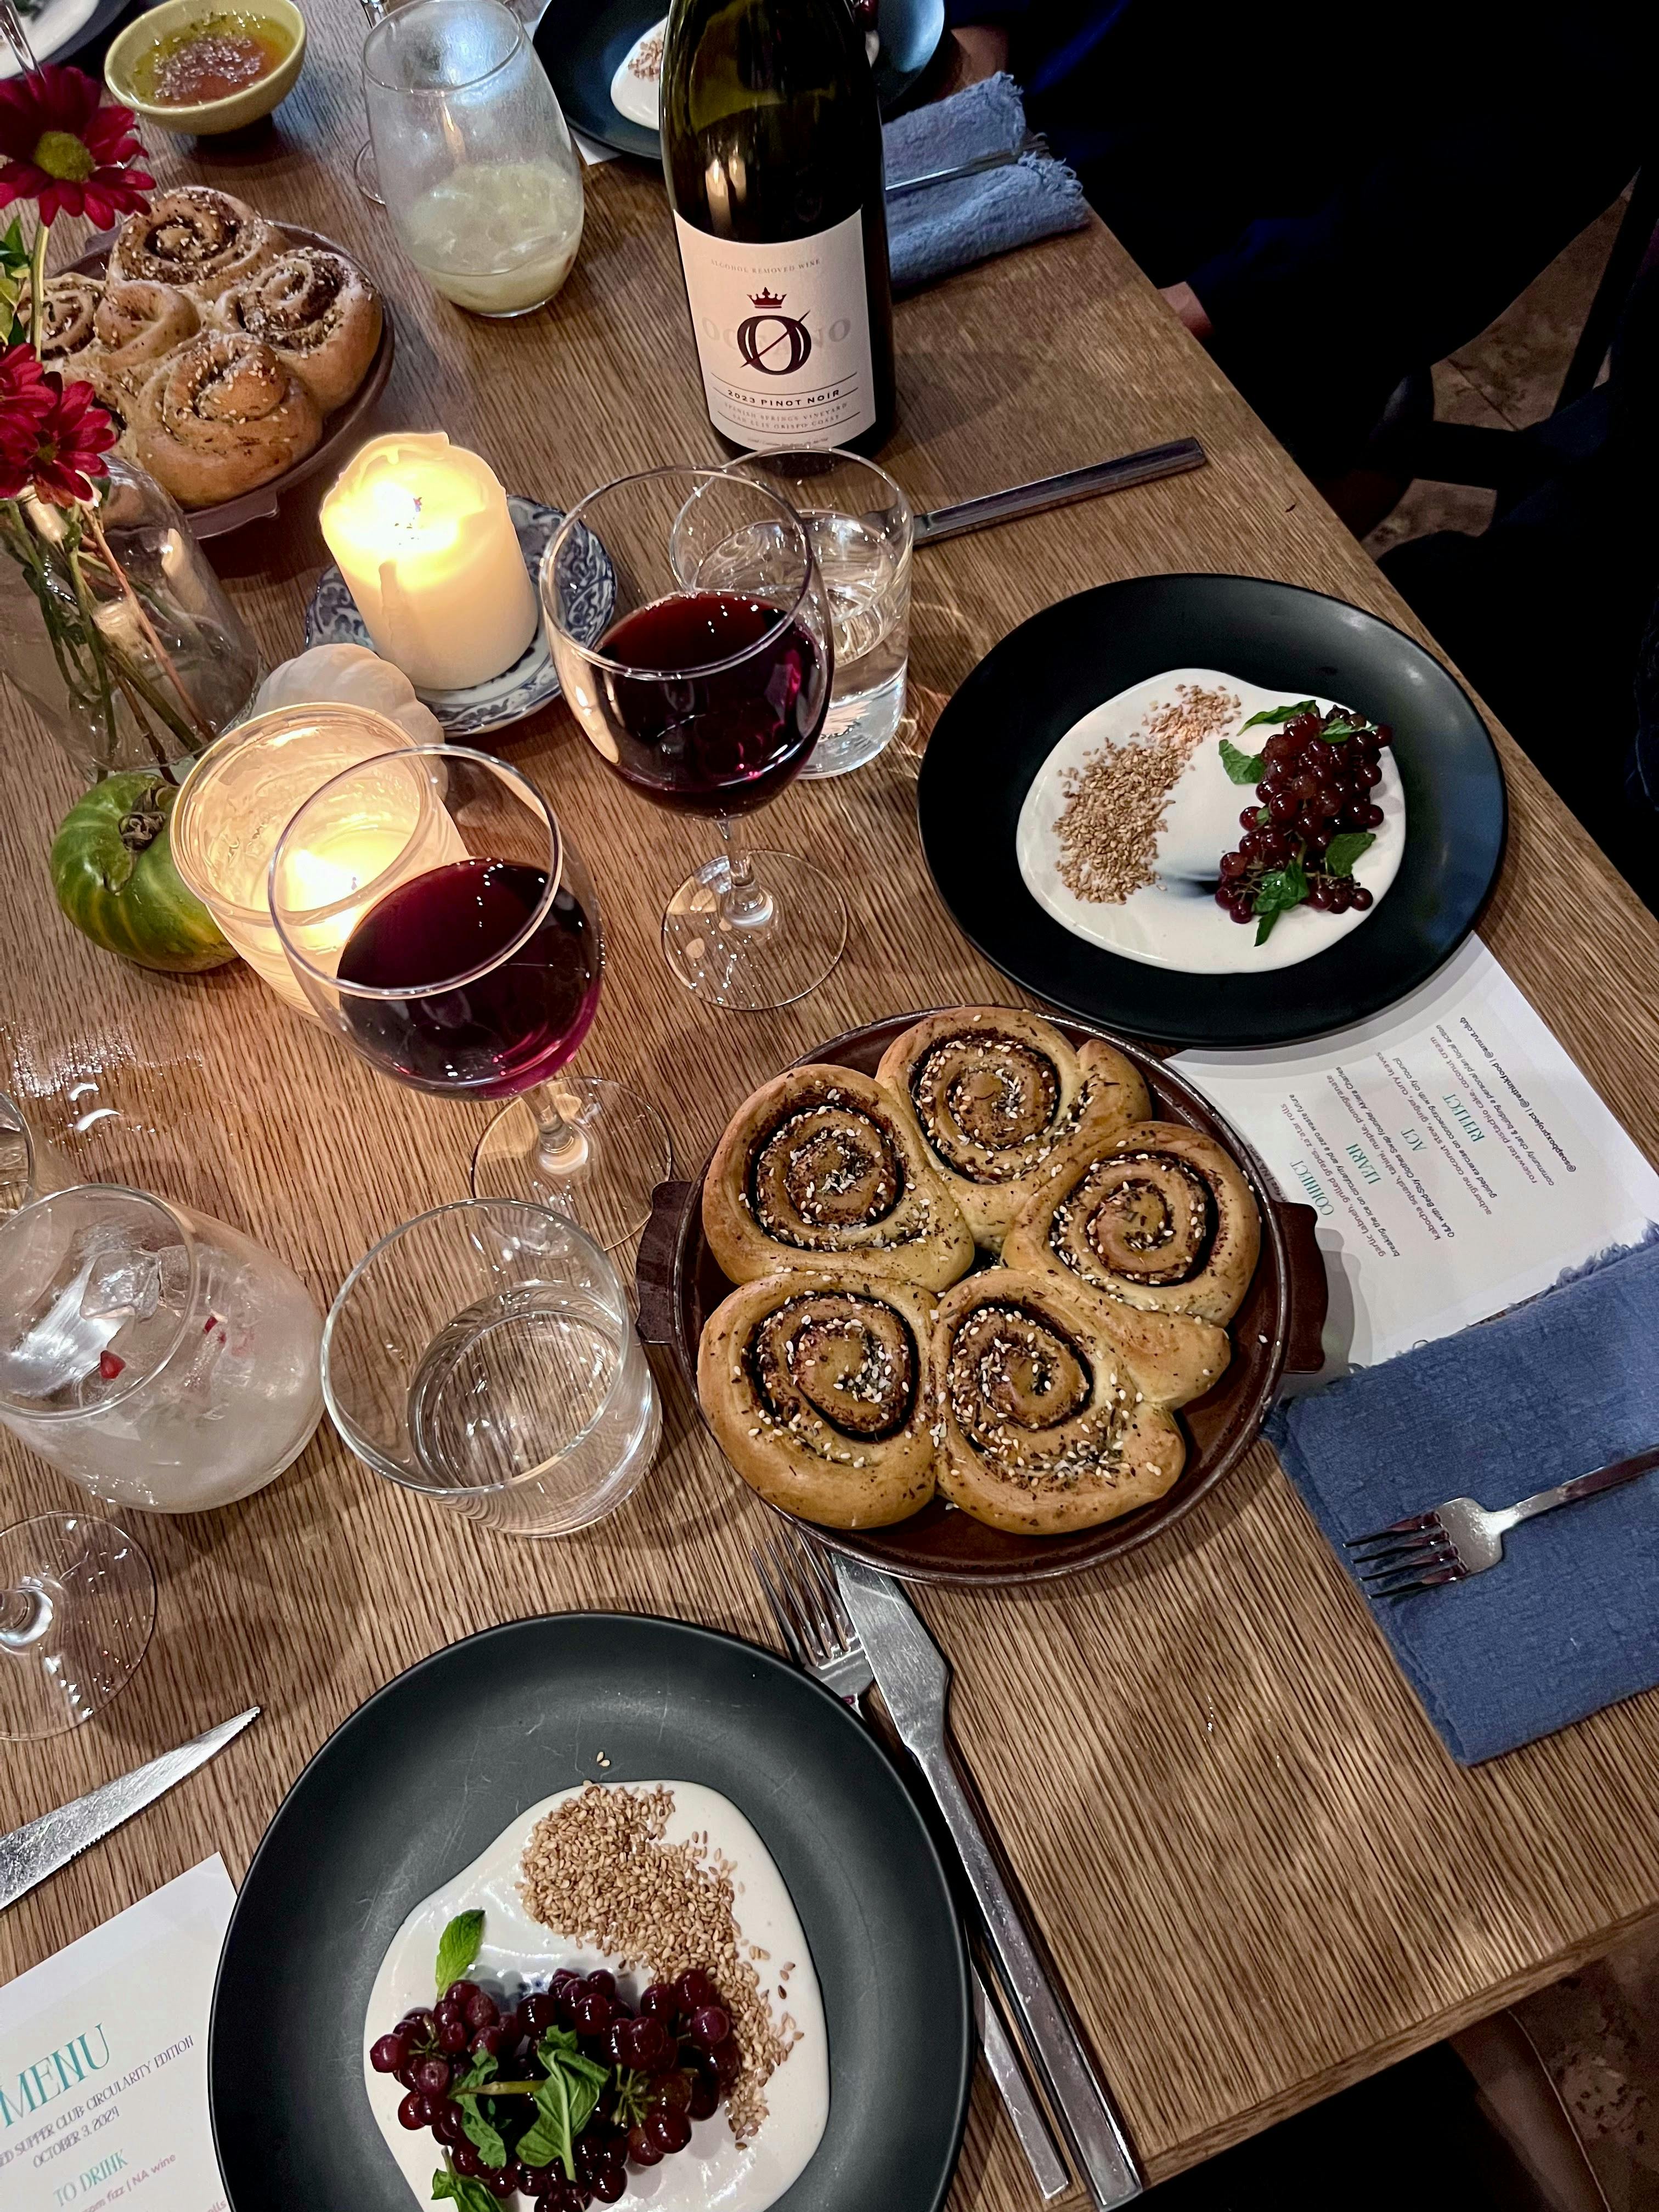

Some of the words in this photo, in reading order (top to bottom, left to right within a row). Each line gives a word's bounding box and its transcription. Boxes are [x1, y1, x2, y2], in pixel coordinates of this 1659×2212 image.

[711, 259, 748, 273] ALCOHOL
[752, 265, 795, 274] REMOVED
[798, 258, 821, 269] WINE
[727, 390, 755, 404] 2023
[807, 390, 840, 404] NOIR
[803, 402, 848, 420] VINEYARD
[1435, 1024, 1453, 1043] action
[1430, 1036, 1449, 1059] cream
[1447, 1043, 1464, 1059] local
[1375, 1052, 1395, 1077] leaves
[1392, 1057, 1413, 1080] council
[1446, 1059, 1470, 1089] coconut
[1460, 1058, 1476, 1073] plan
[1335, 1066, 1354, 1090] Charles
[1392, 1076, 1409, 1096] curry
[1409, 1080, 1421, 1091] city
[1468, 1073, 1495, 1099] personal
[1491, 1062, 1530, 1108] @rethinkfood
[1289, 1094, 1305, 1113] future
[1326, 1075, 1364, 1124] pomegranate
[1351, 1090, 1369, 1109] Akiera
[1407, 1095, 1429, 1122] ginger,
[1417, 1091, 1431, 1105] with
[1469, 1088, 1485, 1109] cake,
[1280, 1103, 1295, 1121] rolls
[1301, 1113, 1317, 1132] waste
[1365, 1109, 1386, 1136] founder,
[1427, 1105, 1455, 1140] connecting
[1441, 1093, 1486, 1142] REFLECT
[1493, 1104, 1515, 1130] building
[1314, 1132, 1328, 1146] zero
[1361, 1123, 1381, 1150] maple,
[1426, 1122, 1443, 1144] stew,
[1482, 1109, 1511, 1144] pistachio
[1382, 1136, 1398, 1154] Swap
[1400, 1128, 1428, 1152] ACT
[1452, 1139, 1462, 1149] on
[1514, 1135, 1529, 1150] chat
[1528, 1111, 1577, 1172] @soapboxproject
[1259, 1162, 1271, 1177] NA
[1311, 1147, 1334, 1177] grapes,
[1325, 1152, 1339, 1164] and
[1345, 1143, 1382, 1185] LEARN
[1376, 1150, 1397, 1176] tahini,
[1395, 1154, 1414, 1178] Clothes
[1440, 1144, 1465, 1176] coconut
[1458, 1149, 1480, 1176] exercise
[1506, 1145, 1538, 1184] rosewater
[1525, 1150, 1555, 1186] community
[1289, 1160, 1335, 1216] CONNECT
[1327, 1177, 1351, 1203] grilled
[1335, 1165, 1360, 1196] circularity
[1396, 1175, 1419, 1206] squash,
[1411, 1179, 1435, 1207] Bed-Stuy
[1475, 1176, 1498, 1199] guided
[1356, 1196, 1366, 1205] on
[1462, 1176, 1492, 1215] aubergine
[1347, 1203, 1369, 1235] labneh,
[1363, 1206, 1374, 1217] ice
[1370, 1216, 1381, 1228] the
[1415, 1206, 1442, 1241] kabocha
[1431, 1207, 1444, 1222] with
[1377, 1228, 1401, 1257] breaking
[1441, 1222, 1455, 1238] Q&A
[1366, 1233, 1386, 1257] garlic
[0, 2022, 110, 2129] MENU
[14, 2123, 55, 2157] SUPPER
[86, 2060, 151, 2112] CIRCULARITY
[153, 2034, 194, 2069] EDITION
[32, 2130, 82, 2169] OCTOBER
[91, 2105, 120, 2132] 2024
[53, 2181, 78, 2208] TO
[79, 2148, 128, 2192] DRINK
[106, 2186, 126, 2203] fizz
[132, 2169, 150, 2186] NA
[150, 2154, 176, 2174] wine
